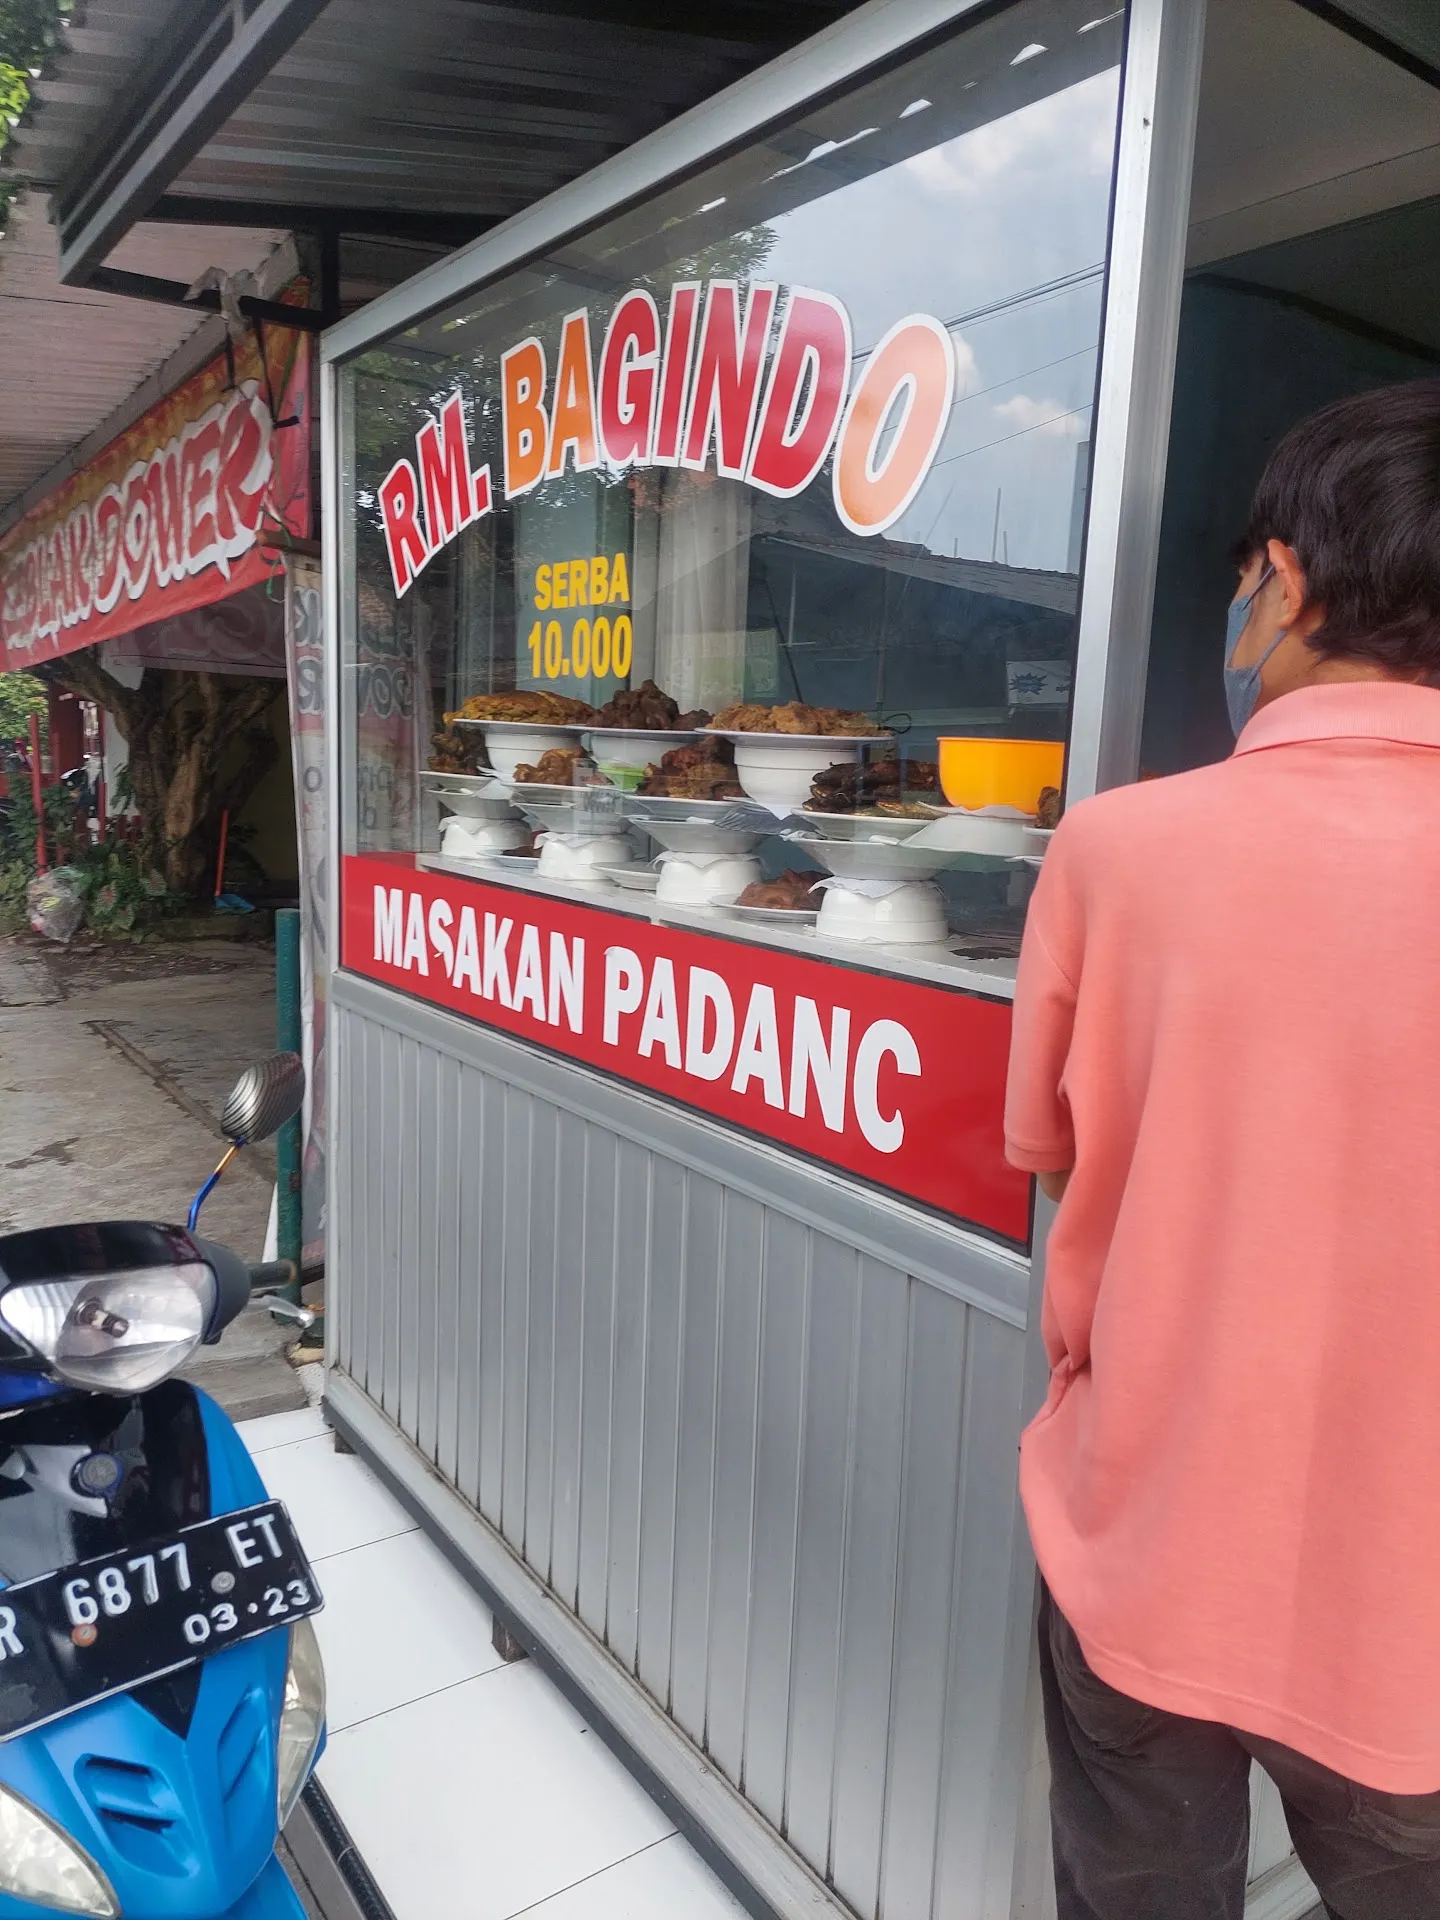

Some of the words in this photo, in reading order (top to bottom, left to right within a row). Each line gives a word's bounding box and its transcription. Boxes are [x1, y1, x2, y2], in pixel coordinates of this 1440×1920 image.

[93, 378, 274, 614] POWER
[377, 389, 493, 599] RM.
[501, 279, 956, 537] BAGINDO
[528, 615, 633, 679] 10.000
[534, 552, 630, 611] SERBA
[373, 884, 586, 1036] MASAKAN
[62, 1542, 192, 1625] 6877
[225, 1513, 283, 1569] ET
